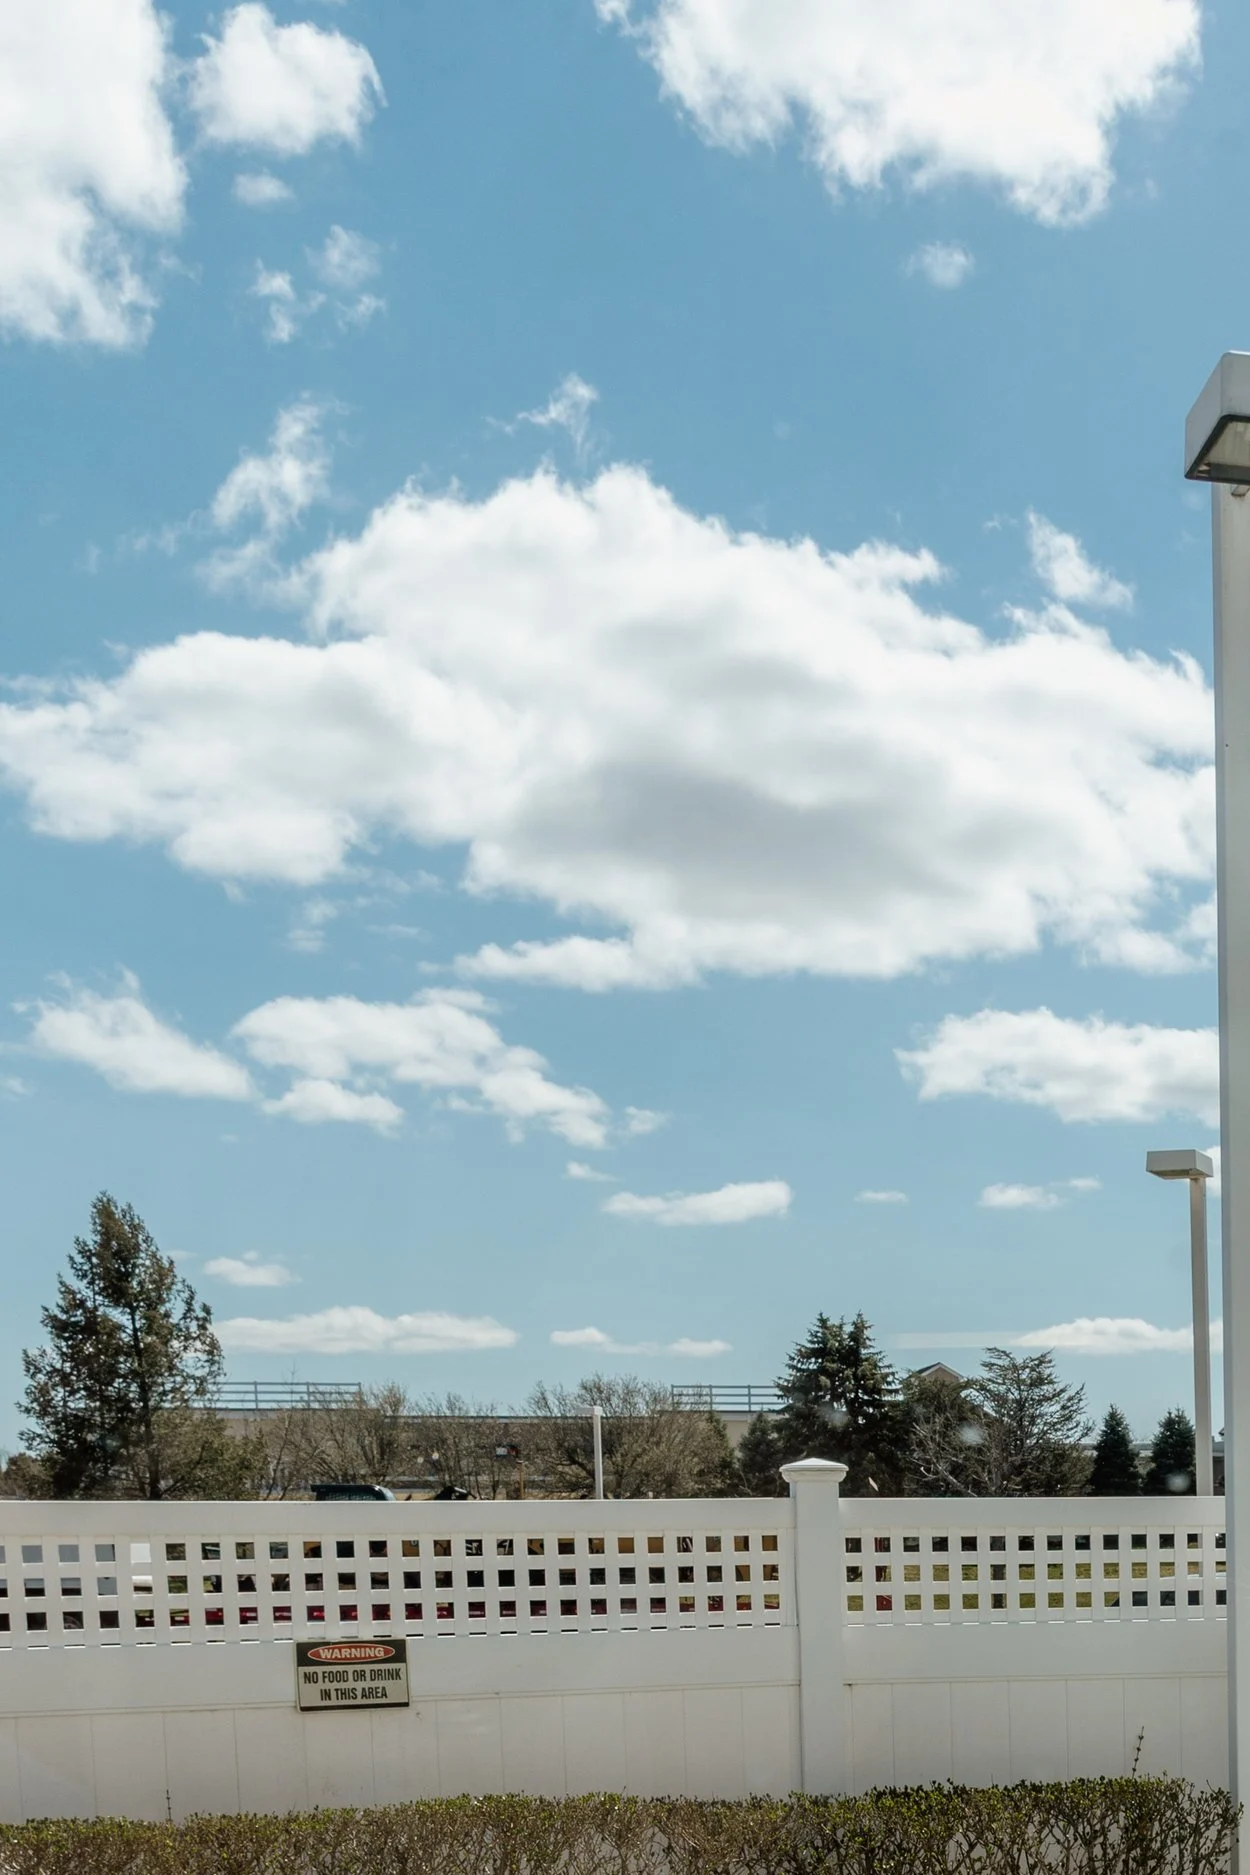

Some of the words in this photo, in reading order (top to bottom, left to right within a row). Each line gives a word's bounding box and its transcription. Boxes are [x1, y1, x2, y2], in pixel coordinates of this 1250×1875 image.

[319, 1647, 385, 1659] WARNING
[303, 1671, 319, 1684] NO
[322, 1670, 349, 1683] FOOD
[352, 1669, 367, 1682] OR
[370, 1668, 402, 1681] DRINK
[320, 1688, 331, 1701] IN
[334, 1687, 357, 1700] THIS
[361, 1686, 388, 1699] AREA
